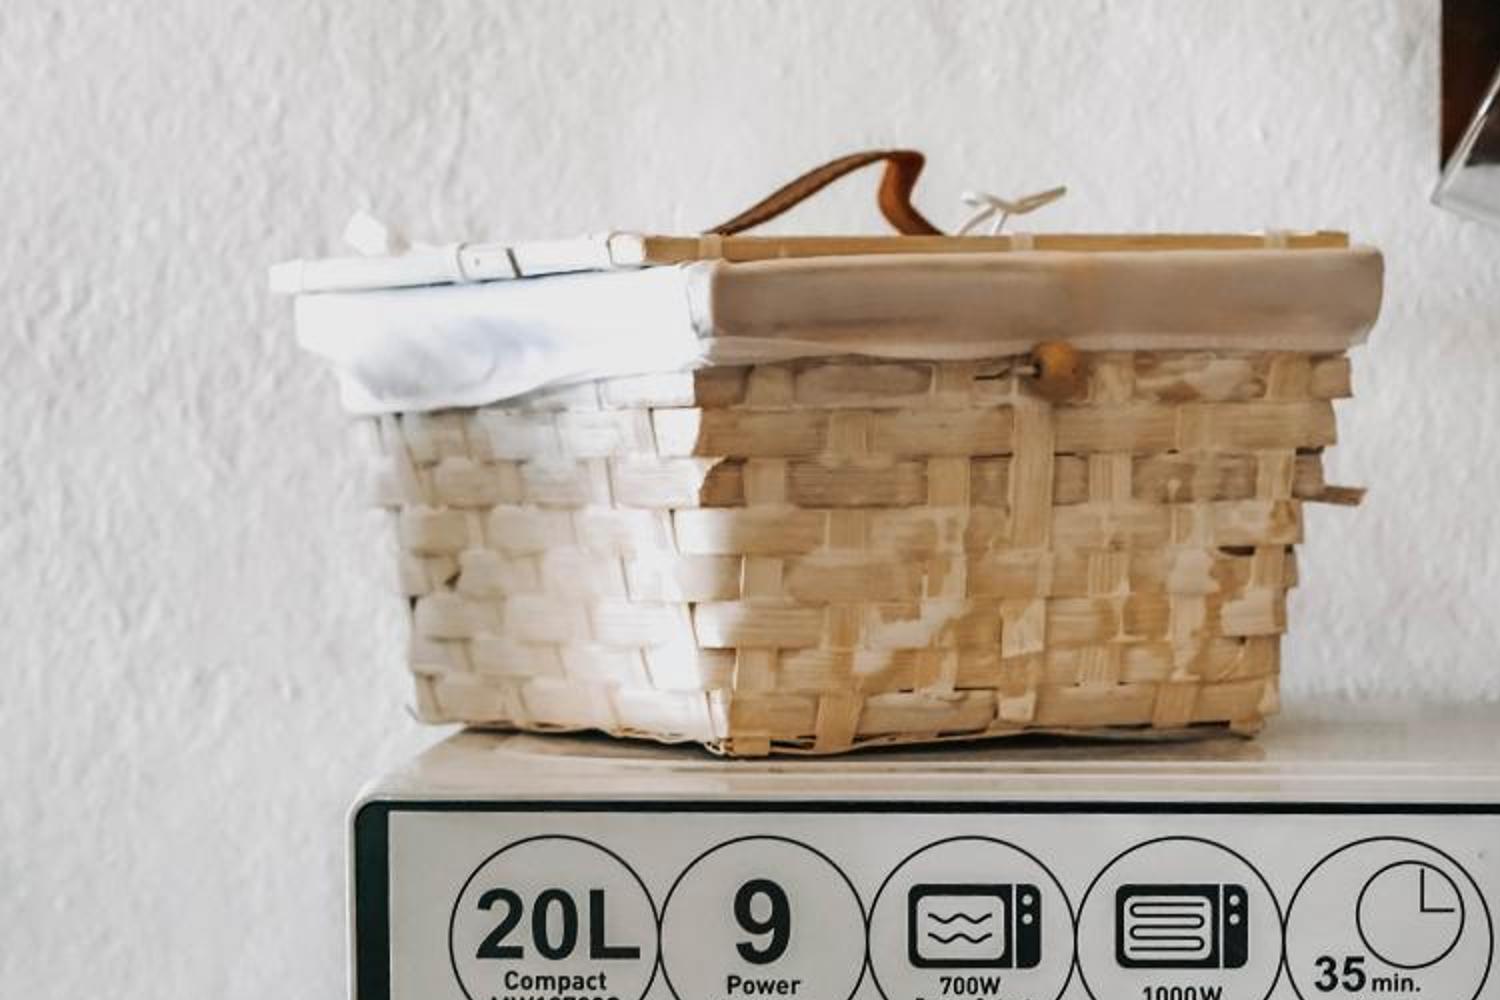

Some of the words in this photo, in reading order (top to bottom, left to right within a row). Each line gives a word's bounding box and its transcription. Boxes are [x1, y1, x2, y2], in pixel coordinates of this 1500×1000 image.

[476, 887, 640, 960] 20L
[733, 878, 791, 965] 9
[503, 971, 606, 994] Compact
[727, 975, 801, 995] Power
[940, 976, 1001, 995] 700W
[1314, 956, 1366, 992] 35
[1372, 973, 1421, 993] min.
